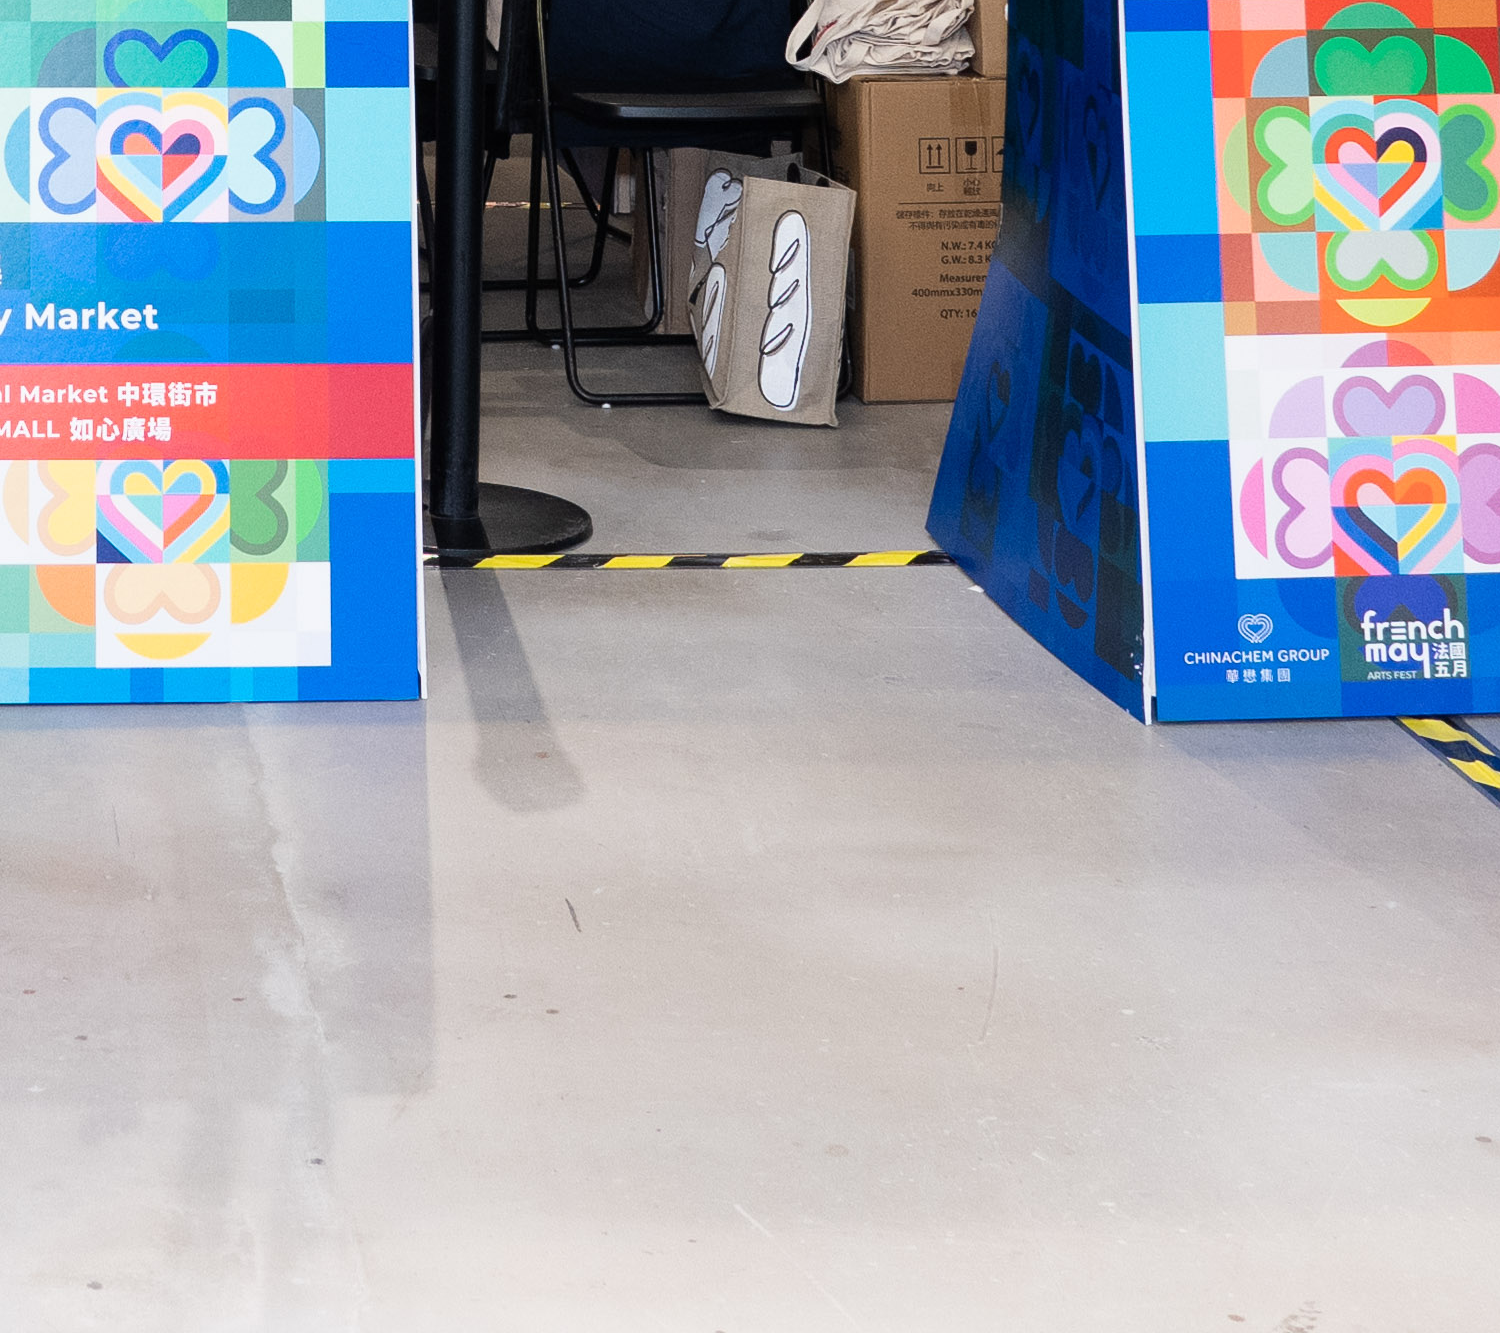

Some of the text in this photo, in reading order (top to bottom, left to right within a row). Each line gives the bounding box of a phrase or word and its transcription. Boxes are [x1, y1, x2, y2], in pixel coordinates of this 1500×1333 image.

[967, 240, 984, 250] 7.4
[967, 255, 983, 265] 8.3
[24, 302, 159, 330] Market
[939, 309, 964, 320] QTY:
[19, 383, 109, 404] Market
[116, 382, 218, 407] 中環街市
[68, 417, 173, 442] 如心廣場
[1360, 607, 1465, 642] french
[1183, 648, 1330, 665] CHINACHEM GROUP
[1432, 642, 1466, 661] 法國
[1364, 642, 1431, 680] may
[1434, 661, 1468, 679] 五月
[1366, 670, 1418, 680] ARTS FEST
